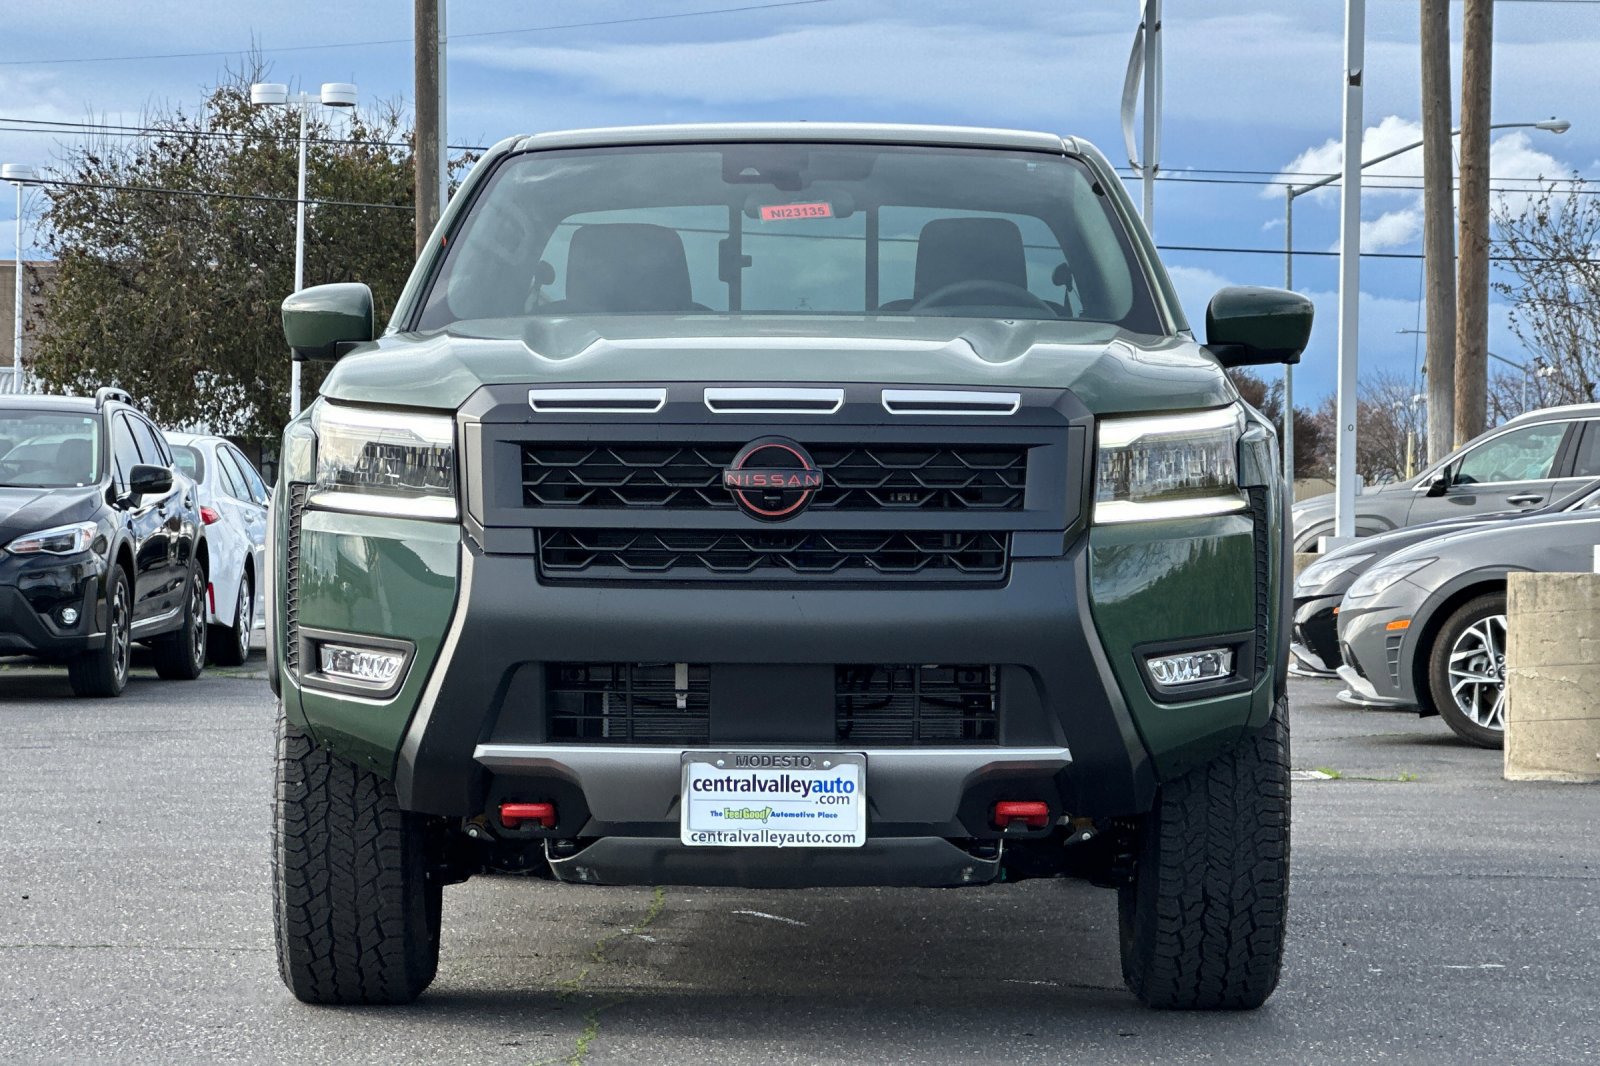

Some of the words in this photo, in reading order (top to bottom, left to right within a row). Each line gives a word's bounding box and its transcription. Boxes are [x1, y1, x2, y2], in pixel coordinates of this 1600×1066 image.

[771, 207, 825, 218] NI23135
[727, 474, 820, 486] NISSAN
[736, 755, 812, 767] MODESTO
[692, 774, 855, 797] centralvalleyauto
[815, 795, 850, 805] .com
[691, 830, 856, 846] centralvalleyauto.com
